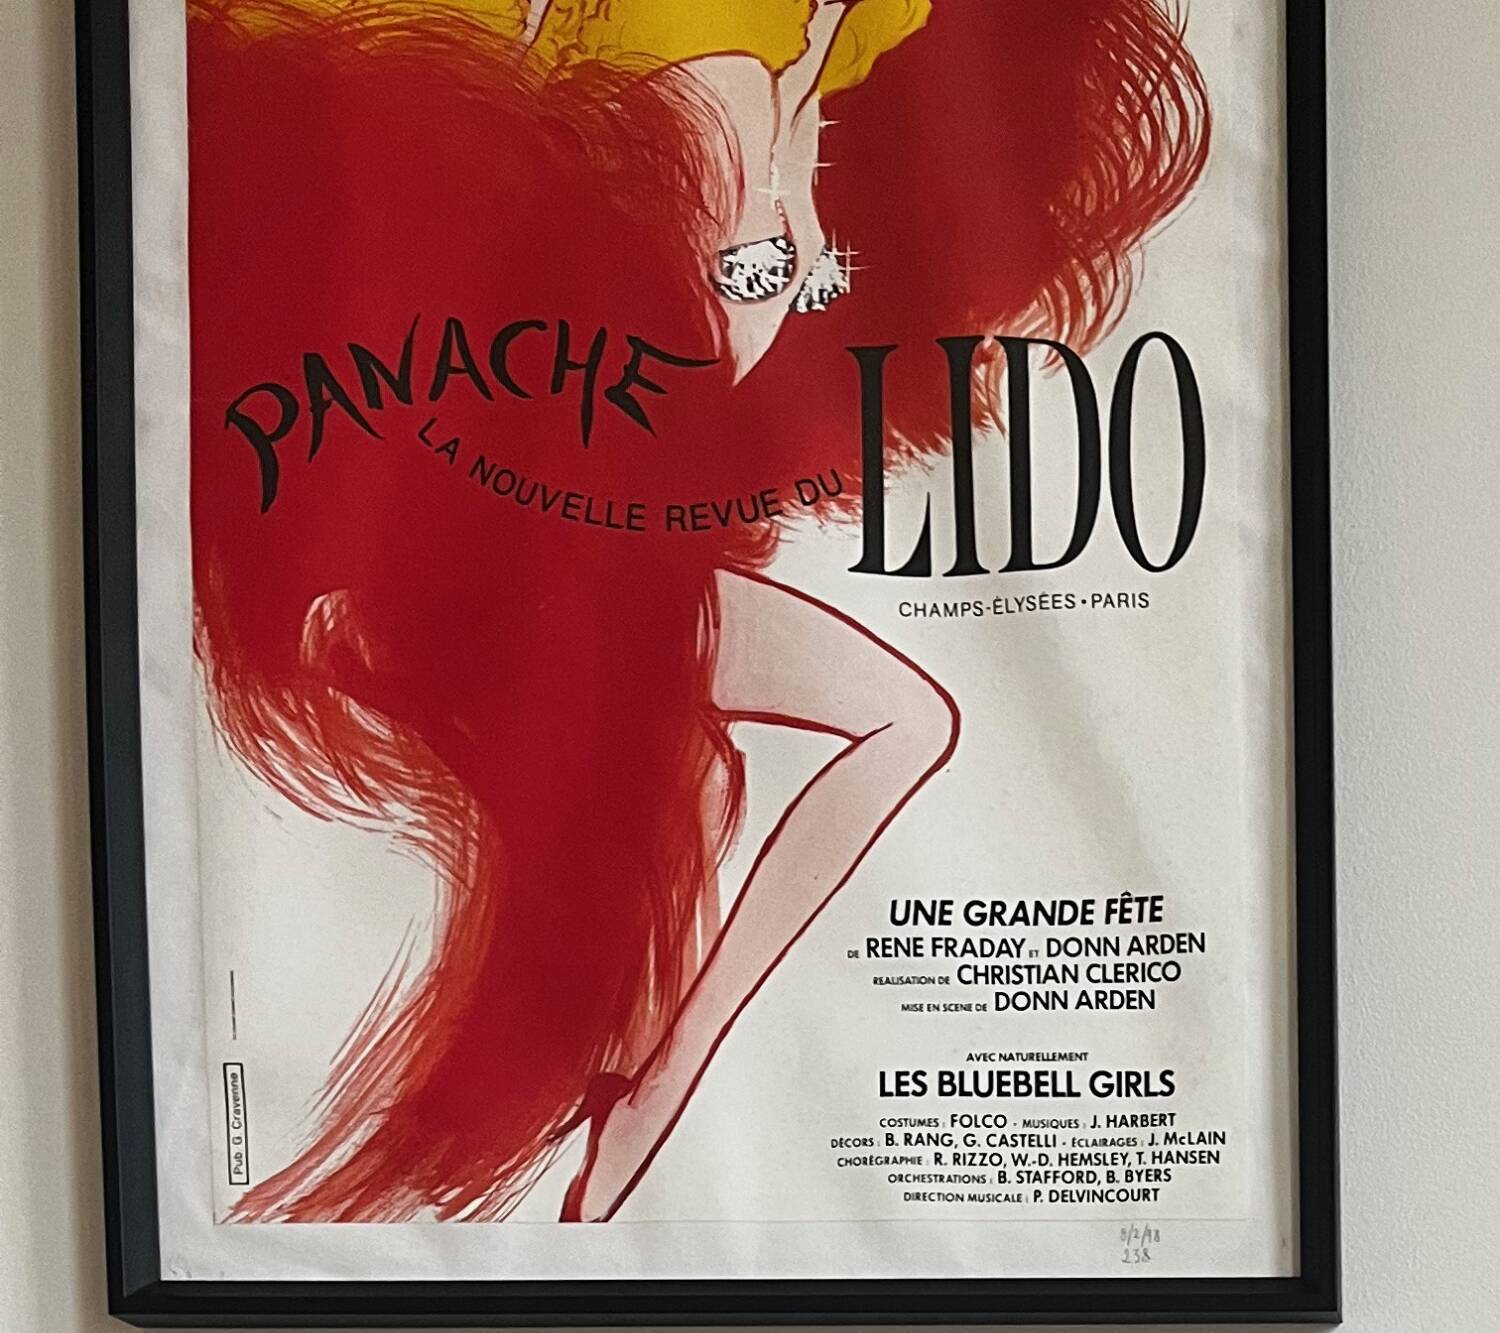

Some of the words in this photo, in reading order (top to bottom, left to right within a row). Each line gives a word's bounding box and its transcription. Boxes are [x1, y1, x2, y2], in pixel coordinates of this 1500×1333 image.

[224, 312, 720, 515] PANACHE
[845, 331, 1206, 578] LIDO
[416, 417, 458, 464] LA
[468, 459, 646, 532] NOUVELLE
[665, 488, 784, 533] REVUE
[795, 468, 844, 507] DU
[1091, 593, 1150, 610] PARIS
[889, 899, 954, 927] UNE
[962, 898, 1095, 928] GRANDE
[1104, 891, 1164, 925] FÊTE
[847, 949, 860, 960] DE
[866, 937, 924, 960] RENE
[931, 937, 1026, 960] FRADAY
[1028, 949, 1040, 959] ET
[1046, 936, 1121, 958] DONN
[1126, 932, 1206, 956] ARDEN
[937, 975, 951, 986] DE
[956, 963, 1080, 986] CHRISTIAN
[1086, 960, 1182, 984] CLERICO
[901, 1003, 924, 1013] MISE
[926, 1003, 941, 1013] EN
[975, 1003, 988, 1013] DE
[994, 991, 1069, 1012] DONN
[1075, 989, 1156, 1011] ARDEN
[966, 1052, 996, 1062] AVEC
[998, 1051, 1089, 1062] NATURELLEMENT
[878, 1071, 928, 1097] LES
[937, 1070, 1082, 1098] BLUEBELL
[1088, 1069, 1176, 1098] GIRLS
[230, 1072, 243, 1130] Cravenne
[950, 1113, 1008, 1128] FOLCO
[1090, 1115, 1102, 1128] J.
[1106, 1112, 1177, 1128] HARBERT
[885, 1132, 900, 1147] B.
[903, 1132, 958, 1150] RANG,
[962, 1133, 982, 1148] G.
[986, 1133, 1057, 1148] CASTELLI
[1148, 1132, 1160, 1147] J.
[1163, 1130, 1226, 1146] McLAIN
[233, 1151, 243, 1175] Pub
[934, 1152, 949, 1167] R.
[952, 1152, 1008, 1169] RIZZO,
[1058, 1151, 1133, 1168] HEMSLEY,
[1136, 1151, 1148, 1166] T.
[1151, 1149, 1221, 1165] HANSEN
[997, 1170, 1012, 1185] B.
[1015, 1170, 1102, 1186] STAFFORD,
[1105, 1170, 1121, 1184] B.
[1124, 1168, 1173, 1183] BYERS
[903, 1191, 965, 1203] DIRECTION
[1033, 1189, 1045, 1204] P.
[1048, 1187, 1161, 1204] DELVINCOURT
